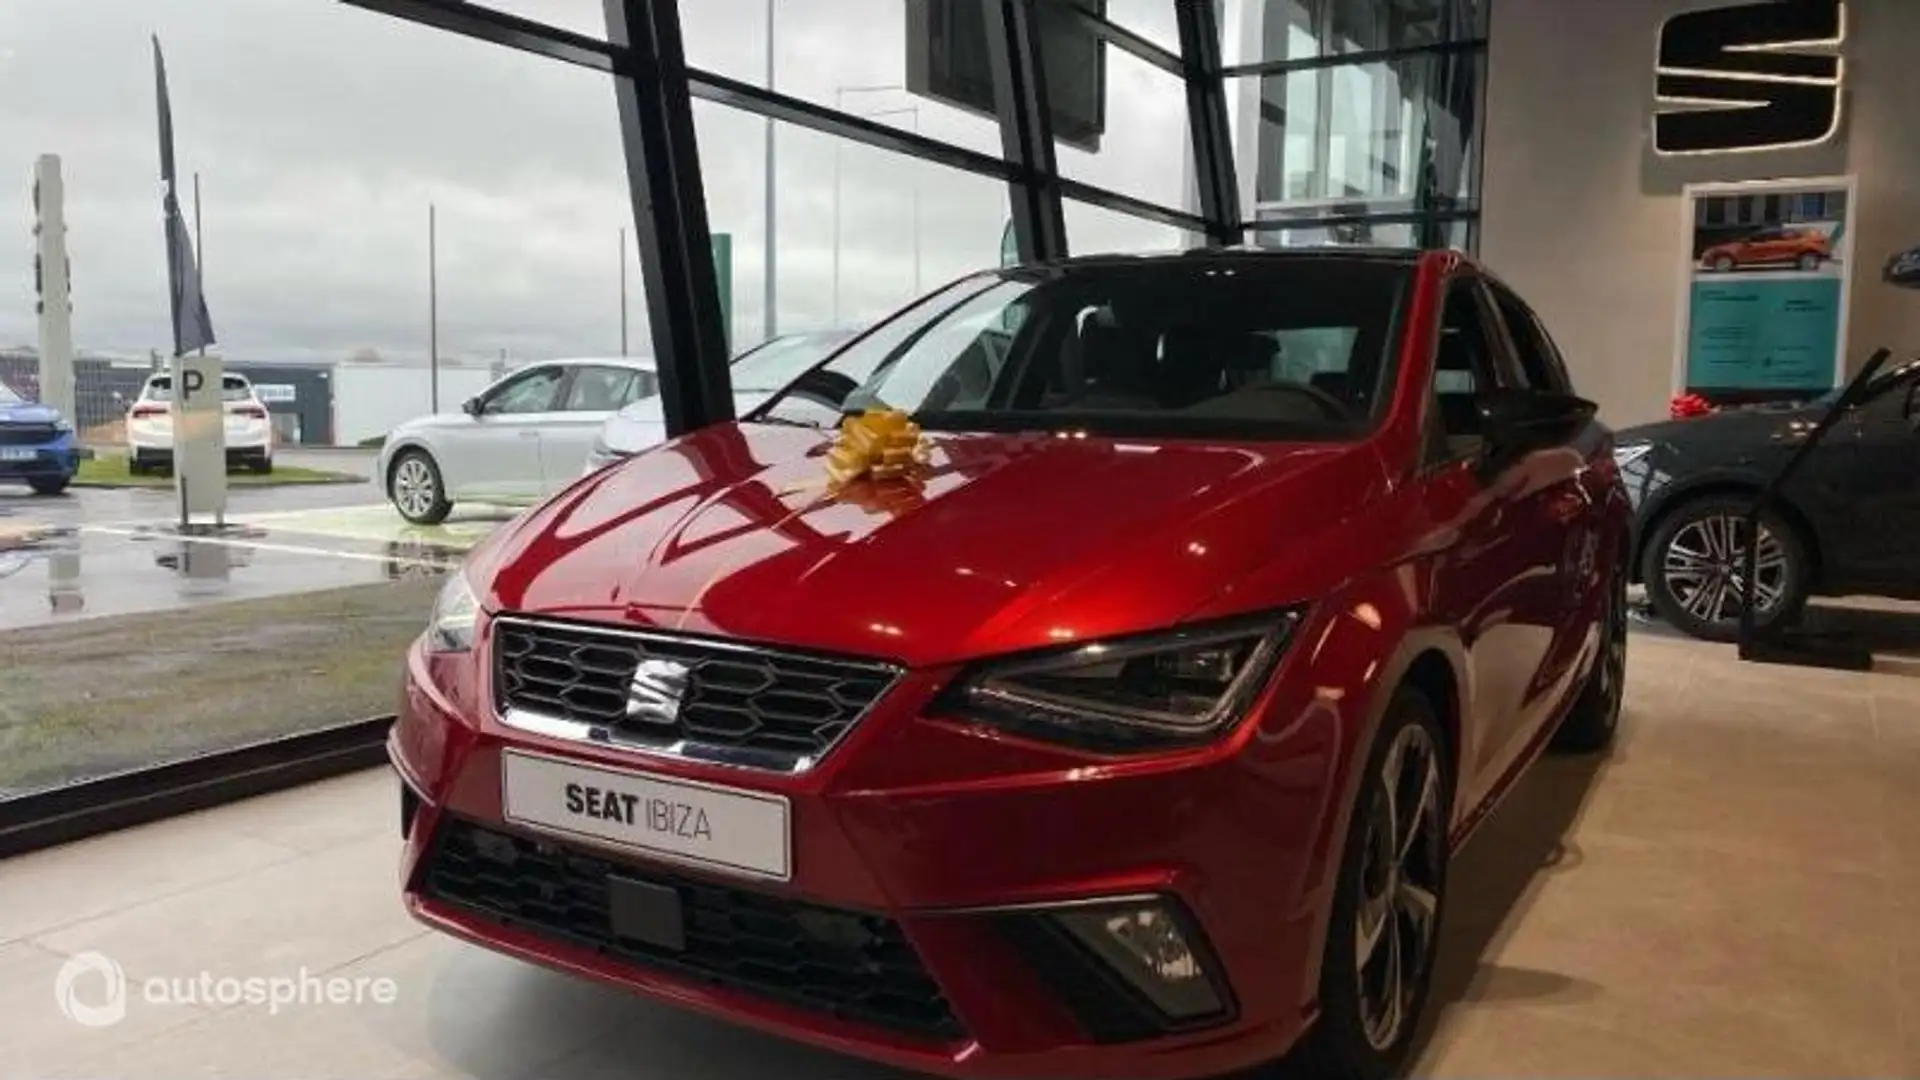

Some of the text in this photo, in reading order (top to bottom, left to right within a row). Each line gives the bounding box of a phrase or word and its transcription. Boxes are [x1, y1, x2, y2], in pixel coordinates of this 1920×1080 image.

[183, 369, 204, 400] P
[566, 783, 712, 842] SEAT IBIZA
